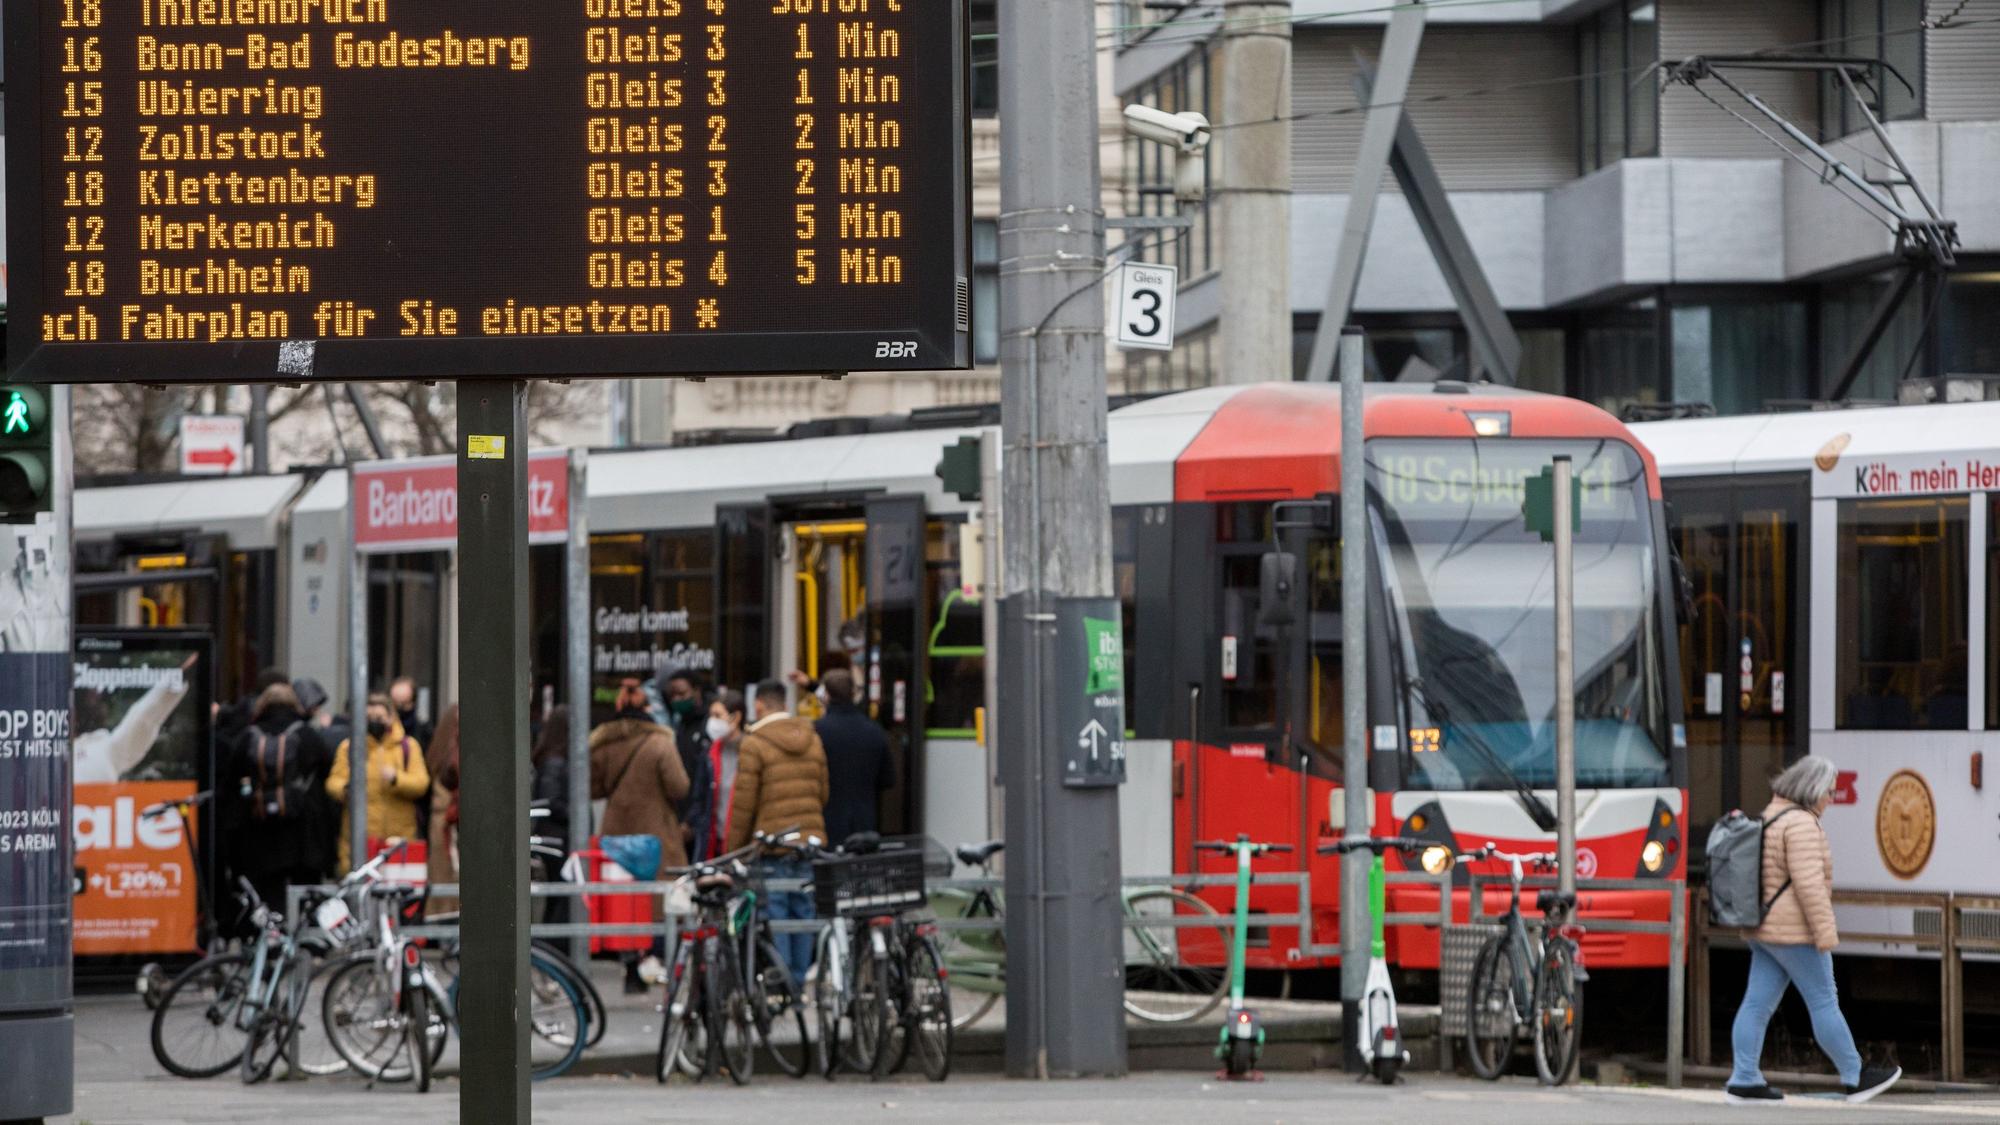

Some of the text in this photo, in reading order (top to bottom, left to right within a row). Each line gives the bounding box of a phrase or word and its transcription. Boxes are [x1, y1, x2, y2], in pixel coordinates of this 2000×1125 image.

[62, 0, 101, 27] 18
[62, 22, 898, 72] 16 Bonn-Bad Godesberg Gleis 3 1 Min
[63, 68, 898, 118] 15 Ubierring Gleis 3 1 Min
[64, 113, 899, 161] 12 Zollstock Gleis 2 2 Min
[64, 158, 899, 207] 18 Klettenberg Gleis 3 2 Min
[65, 203, 900, 251] 12 Merkenich Gleis 1 5 Min
[65, 248, 900, 296] 18 Buchheim Gleis 4 5 Min
[1134, 271, 1162, 284] Gleis
[122, 303, 287, 342] Fahrplan
[314, 302, 375, 336] für
[401, 301, 456, 335] Sie
[483, 300, 670, 334] einsetzen
[1129, 289, 1161, 337] 3
[875, 341, 918, 358] BBR
[1910, 460, 1958, 491] mein
[595, 605, 689, 633] Grüner kommt
[614, 644, 650, 671] kaum
[33, 709, 70, 738] BOYS
[25, 739, 53, 758] HITS
[31, 806, 61, 828] KÖLN
[14, 833, 57, 853] ARENA
